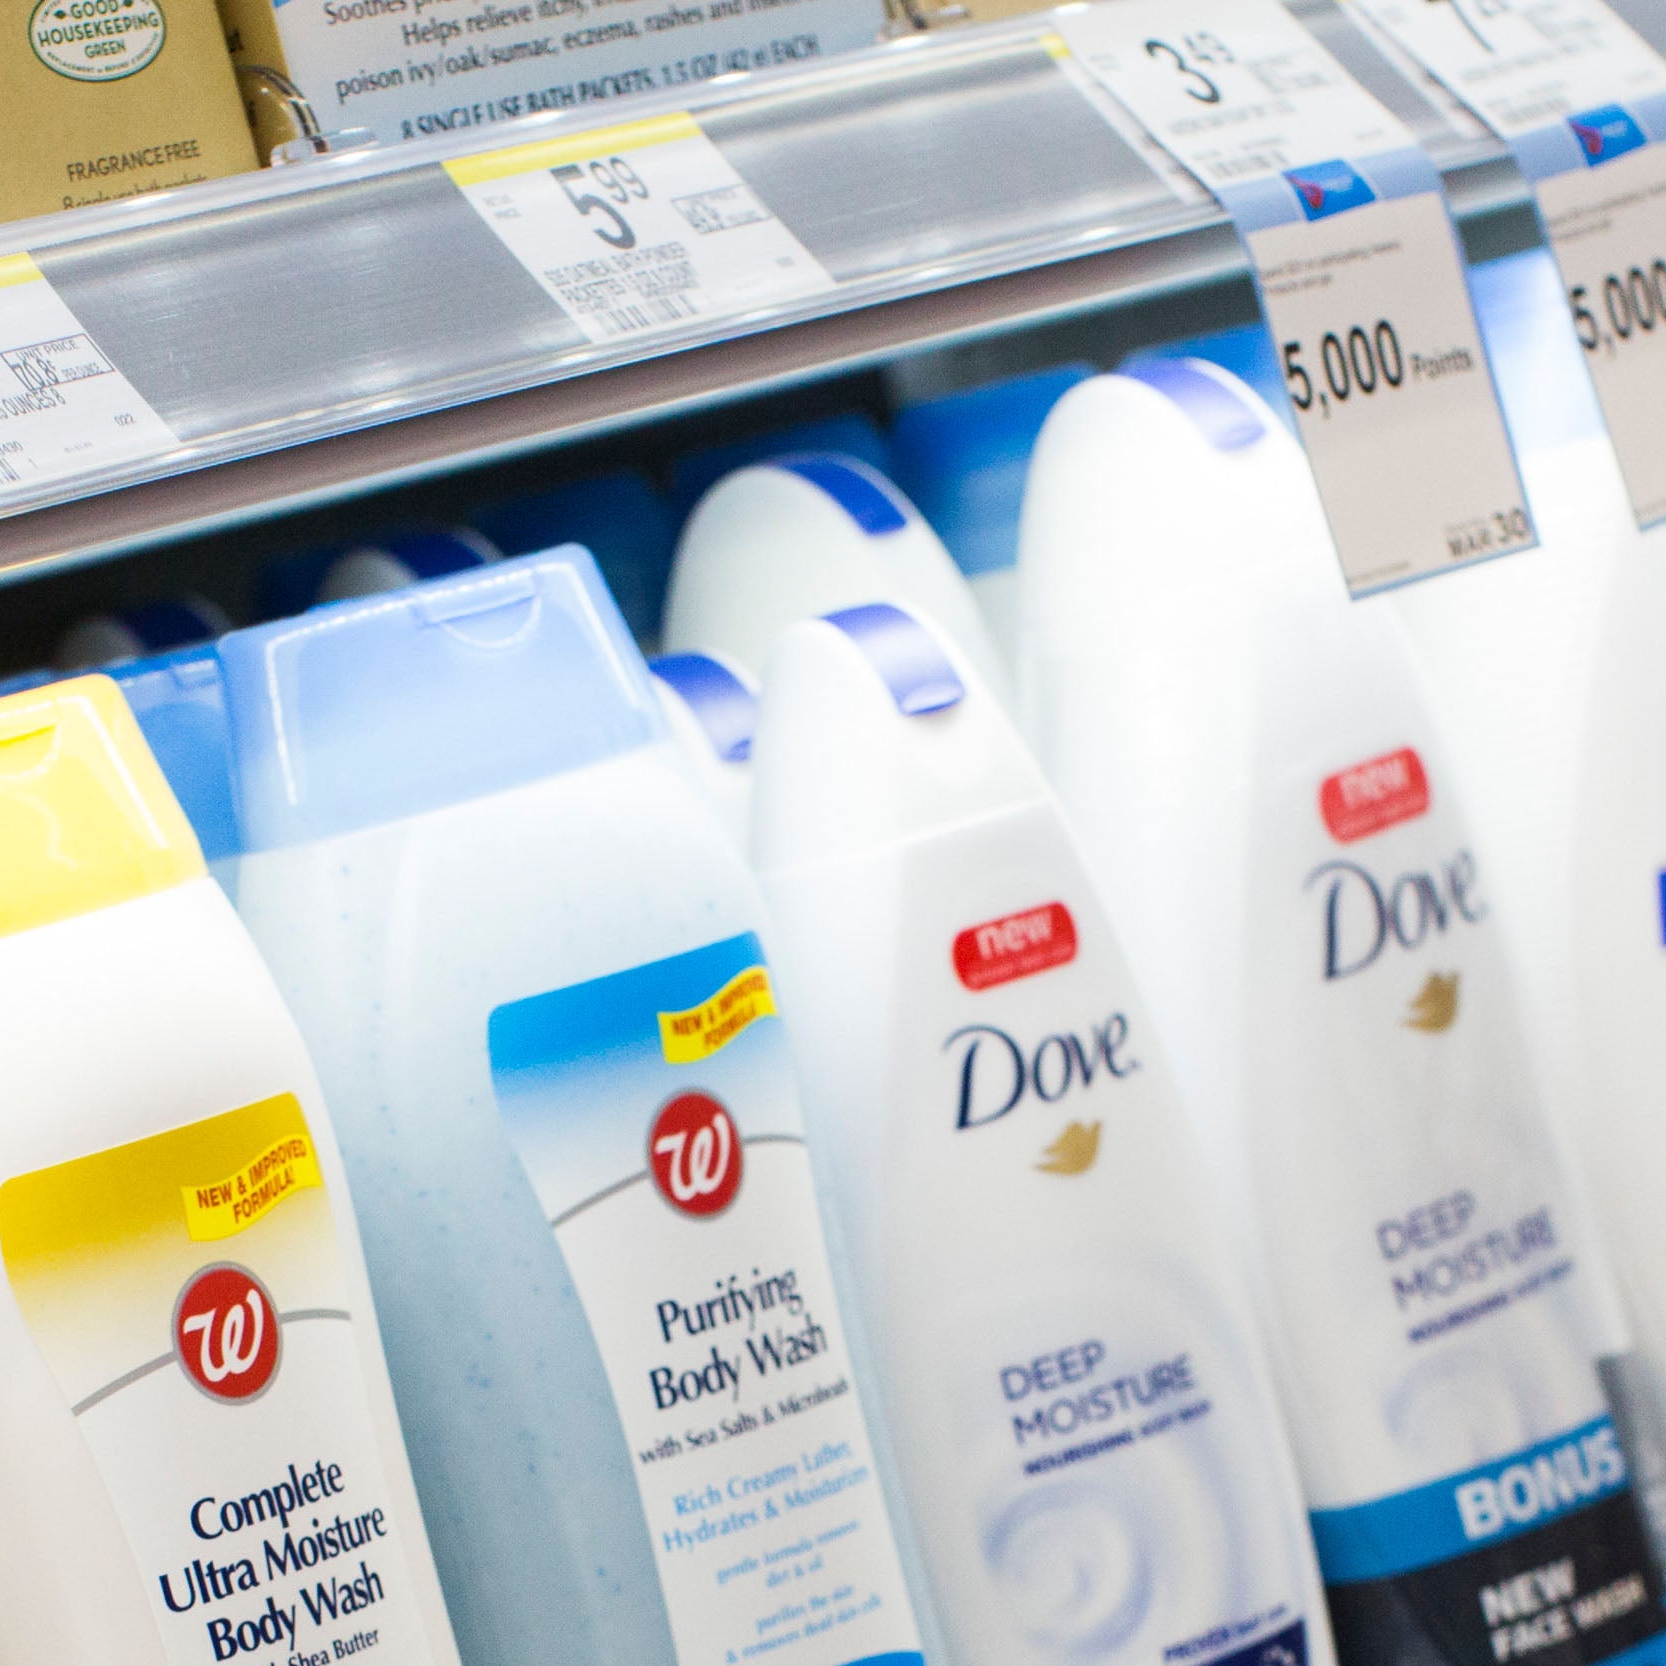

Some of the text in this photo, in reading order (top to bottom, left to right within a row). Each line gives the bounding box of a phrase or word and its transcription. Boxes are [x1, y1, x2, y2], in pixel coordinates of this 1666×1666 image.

[37, 11, 160, 47] HOUSEKEEPING
[84, 39, 126, 58] GREEN
[336, 65, 402, 105] poison
[563, 24, 640, 51] eczema,
[646, 5, 705, 34] rashes
[402, 11, 462, 46] Helps
[467, 5, 533, 34] relieve
[66, 139, 202, 183] FRAGRANCE FREE
[1283, 318, 1474, 421] 5,000 Points
[975, 909, 1053, 960] new
[1303, 850, 1486, 982] Dove
[941, 1010, 1141, 1131] Dove
[197, 1137, 307, 1212] NEW & IMPROVED
[1375, 1190, 1473, 1260] DEEP
[656, 1266, 803, 1343] Purifying
[649, 1312, 828, 1411] Body Wash
[999, 1339, 1105, 1402] DEEP
[1012, 1352, 1197, 1444] MOISTURE
[190, 1460, 345, 1541] Complete
[1455, 1426, 1627, 1541] BONUS
[158, 1505, 387, 1614] Ultra Moisture
[1480, 1555, 1575, 1625] NEW
[206, 1561, 385, 1663] Body Wash
[332, 1628, 380, 1659] Butter
[1490, 1608, 1574, 1662] FACE
